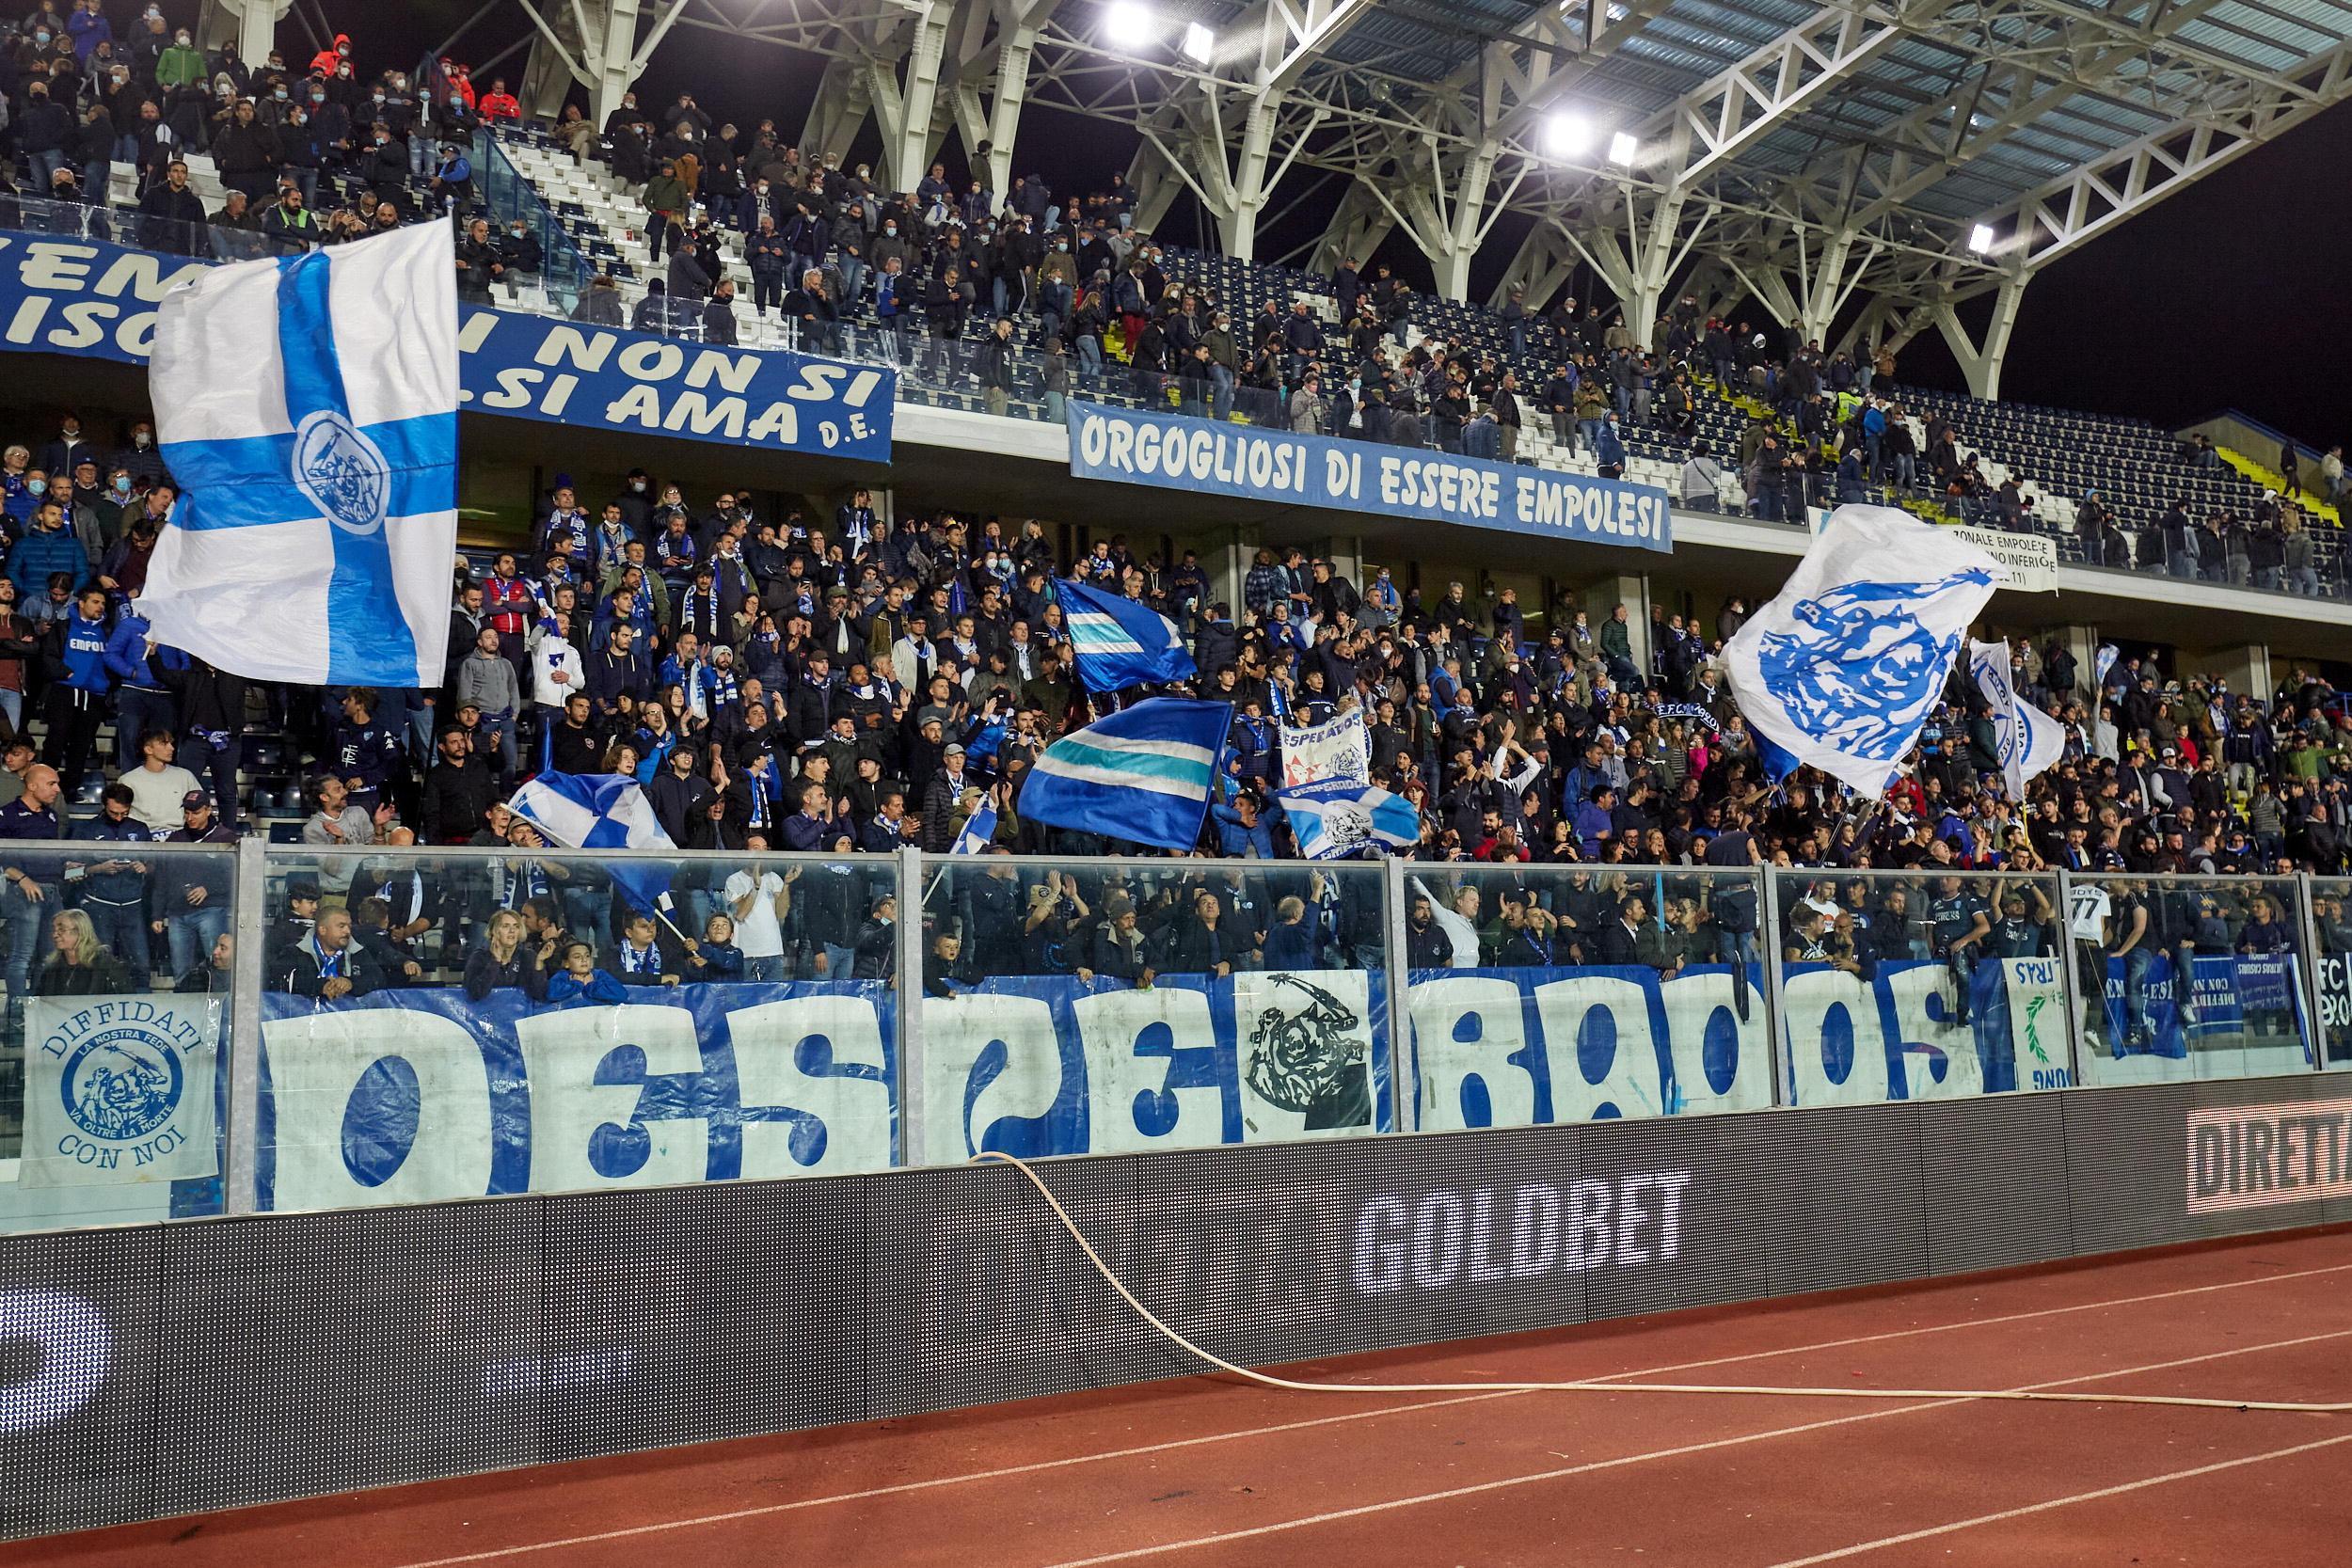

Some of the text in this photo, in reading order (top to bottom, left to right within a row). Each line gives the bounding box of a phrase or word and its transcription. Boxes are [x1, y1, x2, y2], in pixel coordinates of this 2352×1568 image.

[533, 325, 763, 394] NON
[787, 364, 882, 407] SI
[605, 384, 799, 445] AMA
[1081, 415, 1662, 542] ORGOGLIOSI DI ESSERE EMPOLESI
[1996, 536, 2048, 555] EMPOLEE
[2071, 897, 2100, 920] 77
[42, 1001, 204, 1060] DIFFIDATI
[79, 1030, 170, 1056] LA NOSTRA FEDE
[58, 1124, 188, 1169] CON NOI
[69, 1103, 175, 1138] VA OLTRE LA MORTE
[1353, 1170, 1692, 1296] GOLDBET
